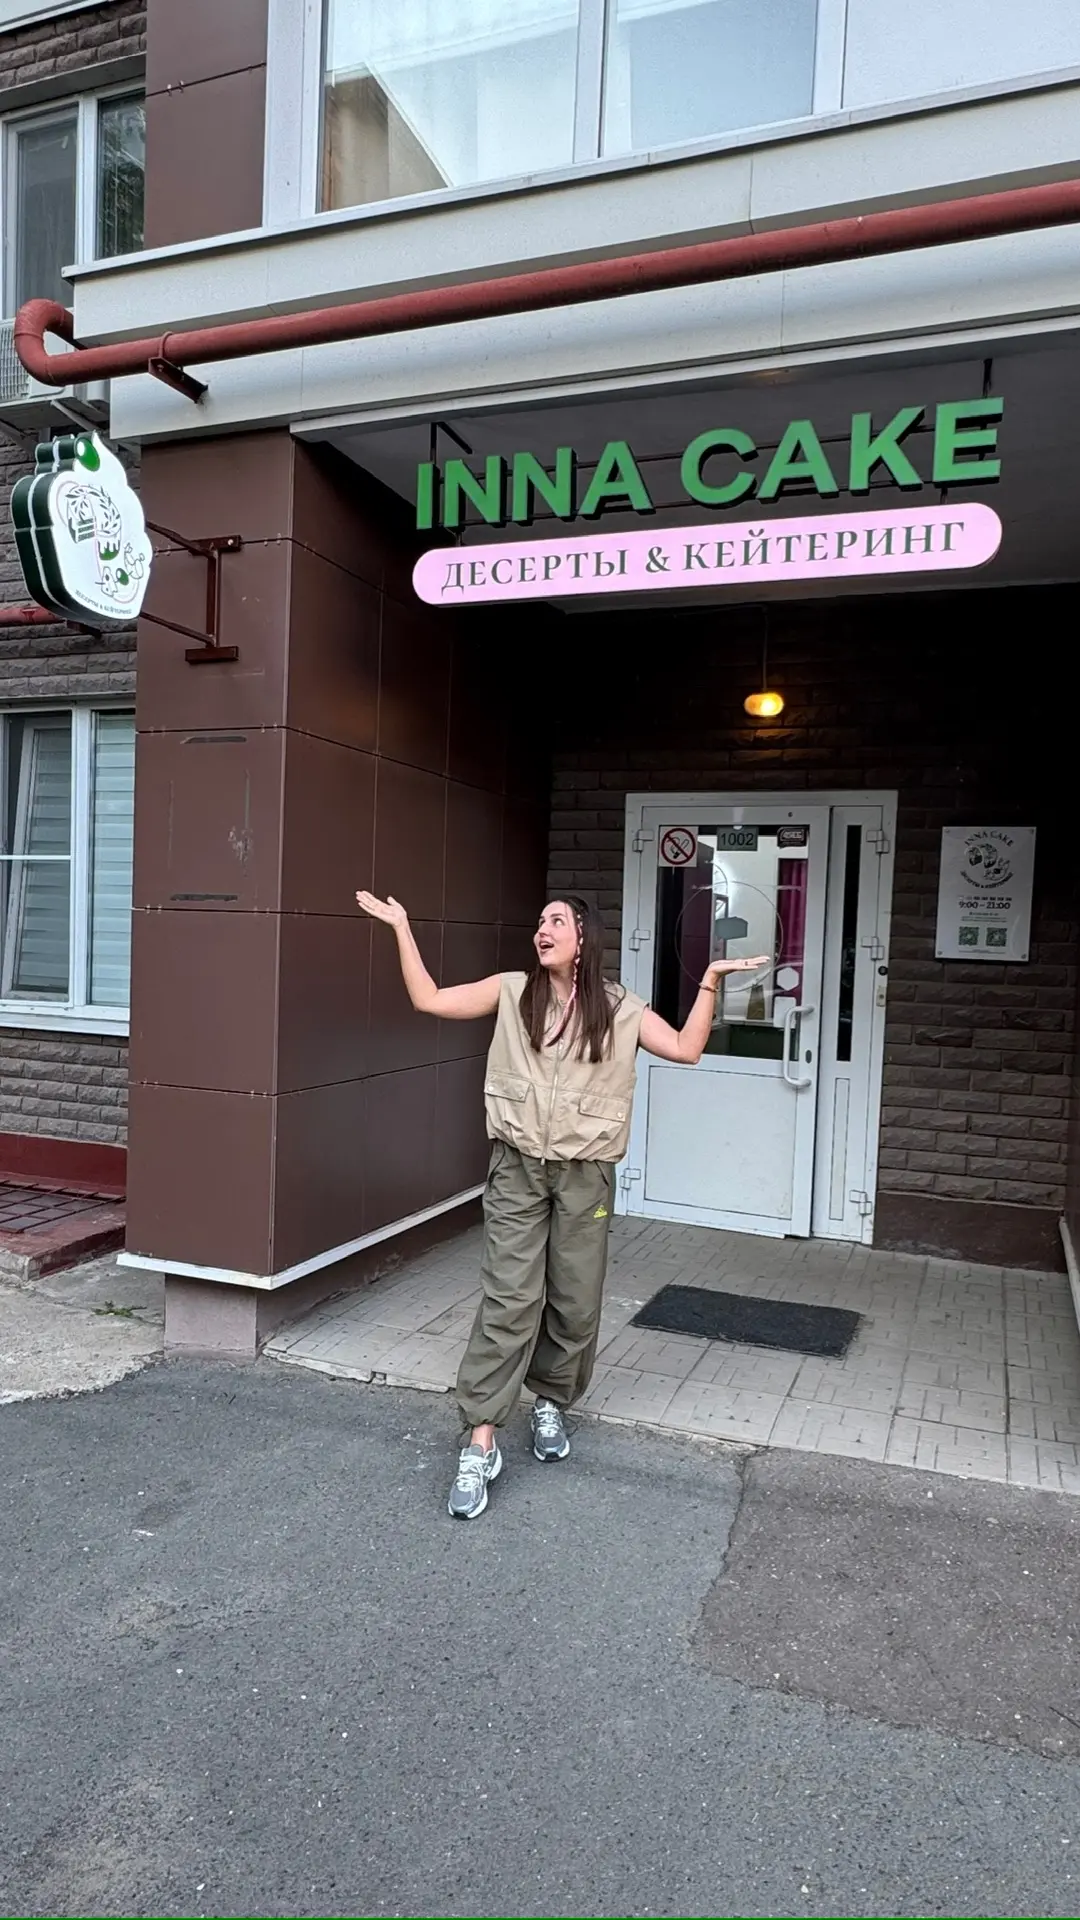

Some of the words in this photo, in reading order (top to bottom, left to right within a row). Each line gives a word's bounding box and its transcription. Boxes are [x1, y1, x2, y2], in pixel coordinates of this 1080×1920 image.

[416, 440, 653, 530] INNA
[680, 396, 1005, 506] CAKE
[440, 548, 629, 597] ДЕСЕРТЫ
[644, 546, 672, 574] &
[683, 520, 966, 571] КЕЙТЕРИНГ
[720, 832, 754, 846] 1002
[986, 901, 1011, 909] 21:00
